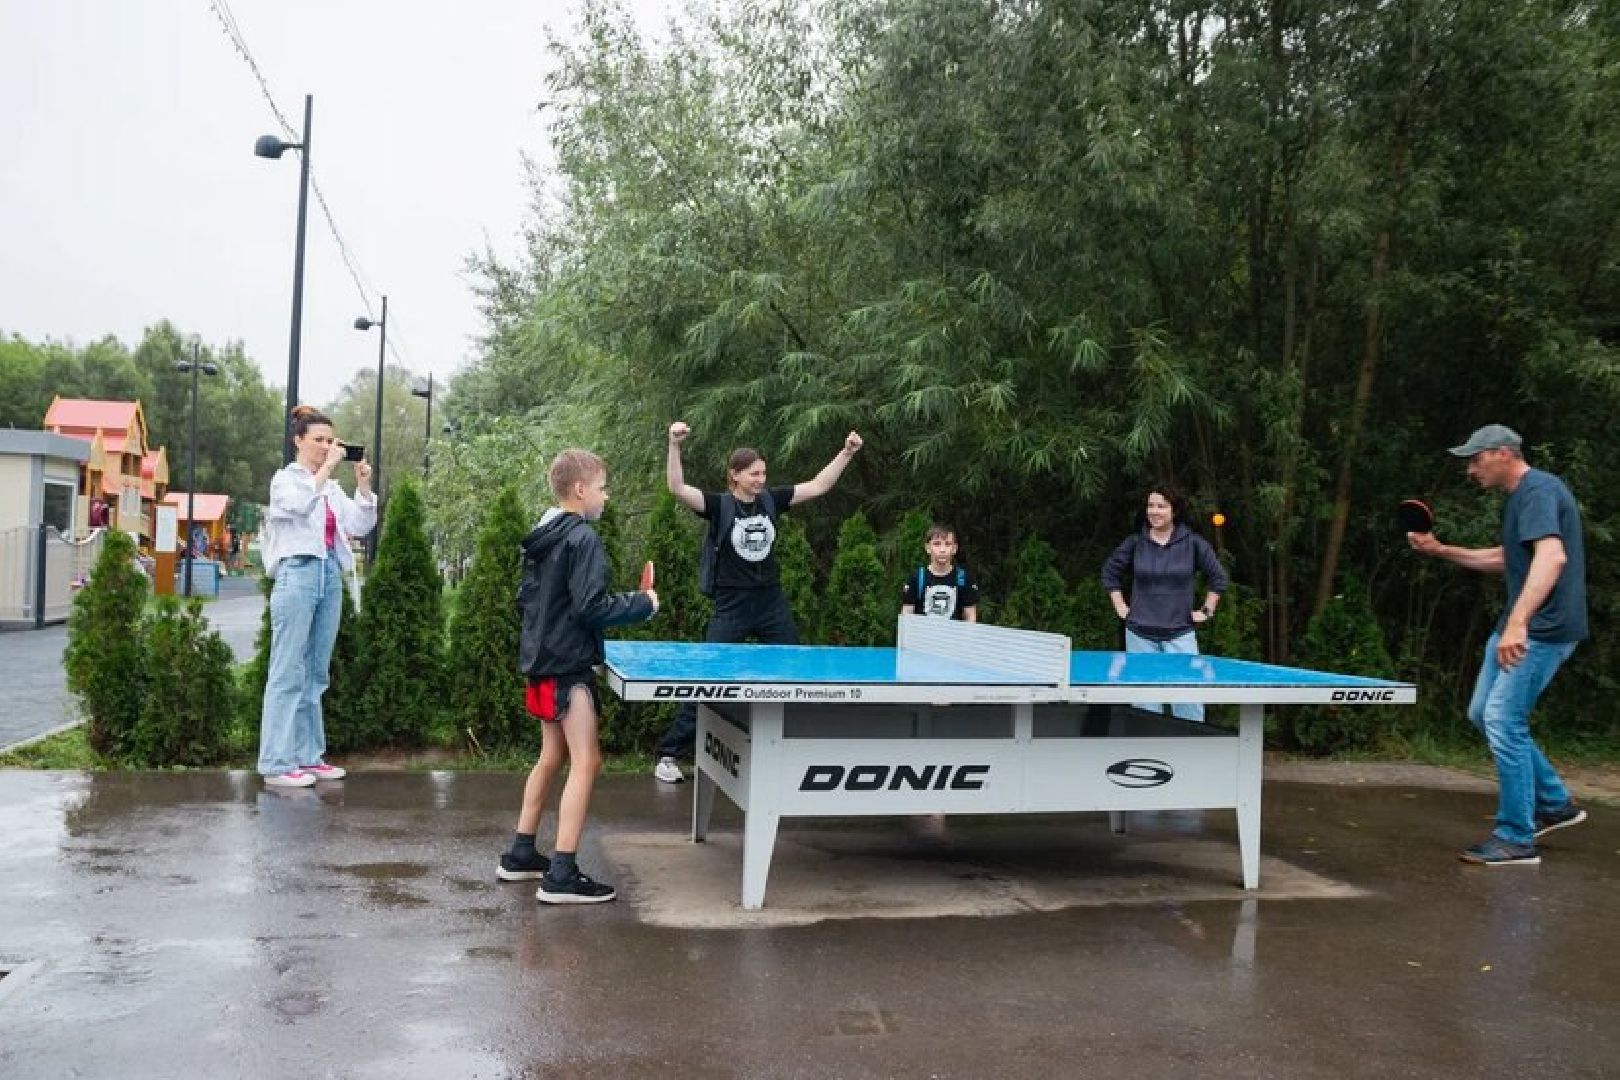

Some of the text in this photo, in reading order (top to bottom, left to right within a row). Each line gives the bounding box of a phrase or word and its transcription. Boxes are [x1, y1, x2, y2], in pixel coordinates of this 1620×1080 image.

[653, 686, 862, 699] DONIC Outdoor Premium 10
[1331, 689, 1395, 701] DONIC
[704, 731, 740, 778] DONIC
[798, 765, 990, 790] DONIC
